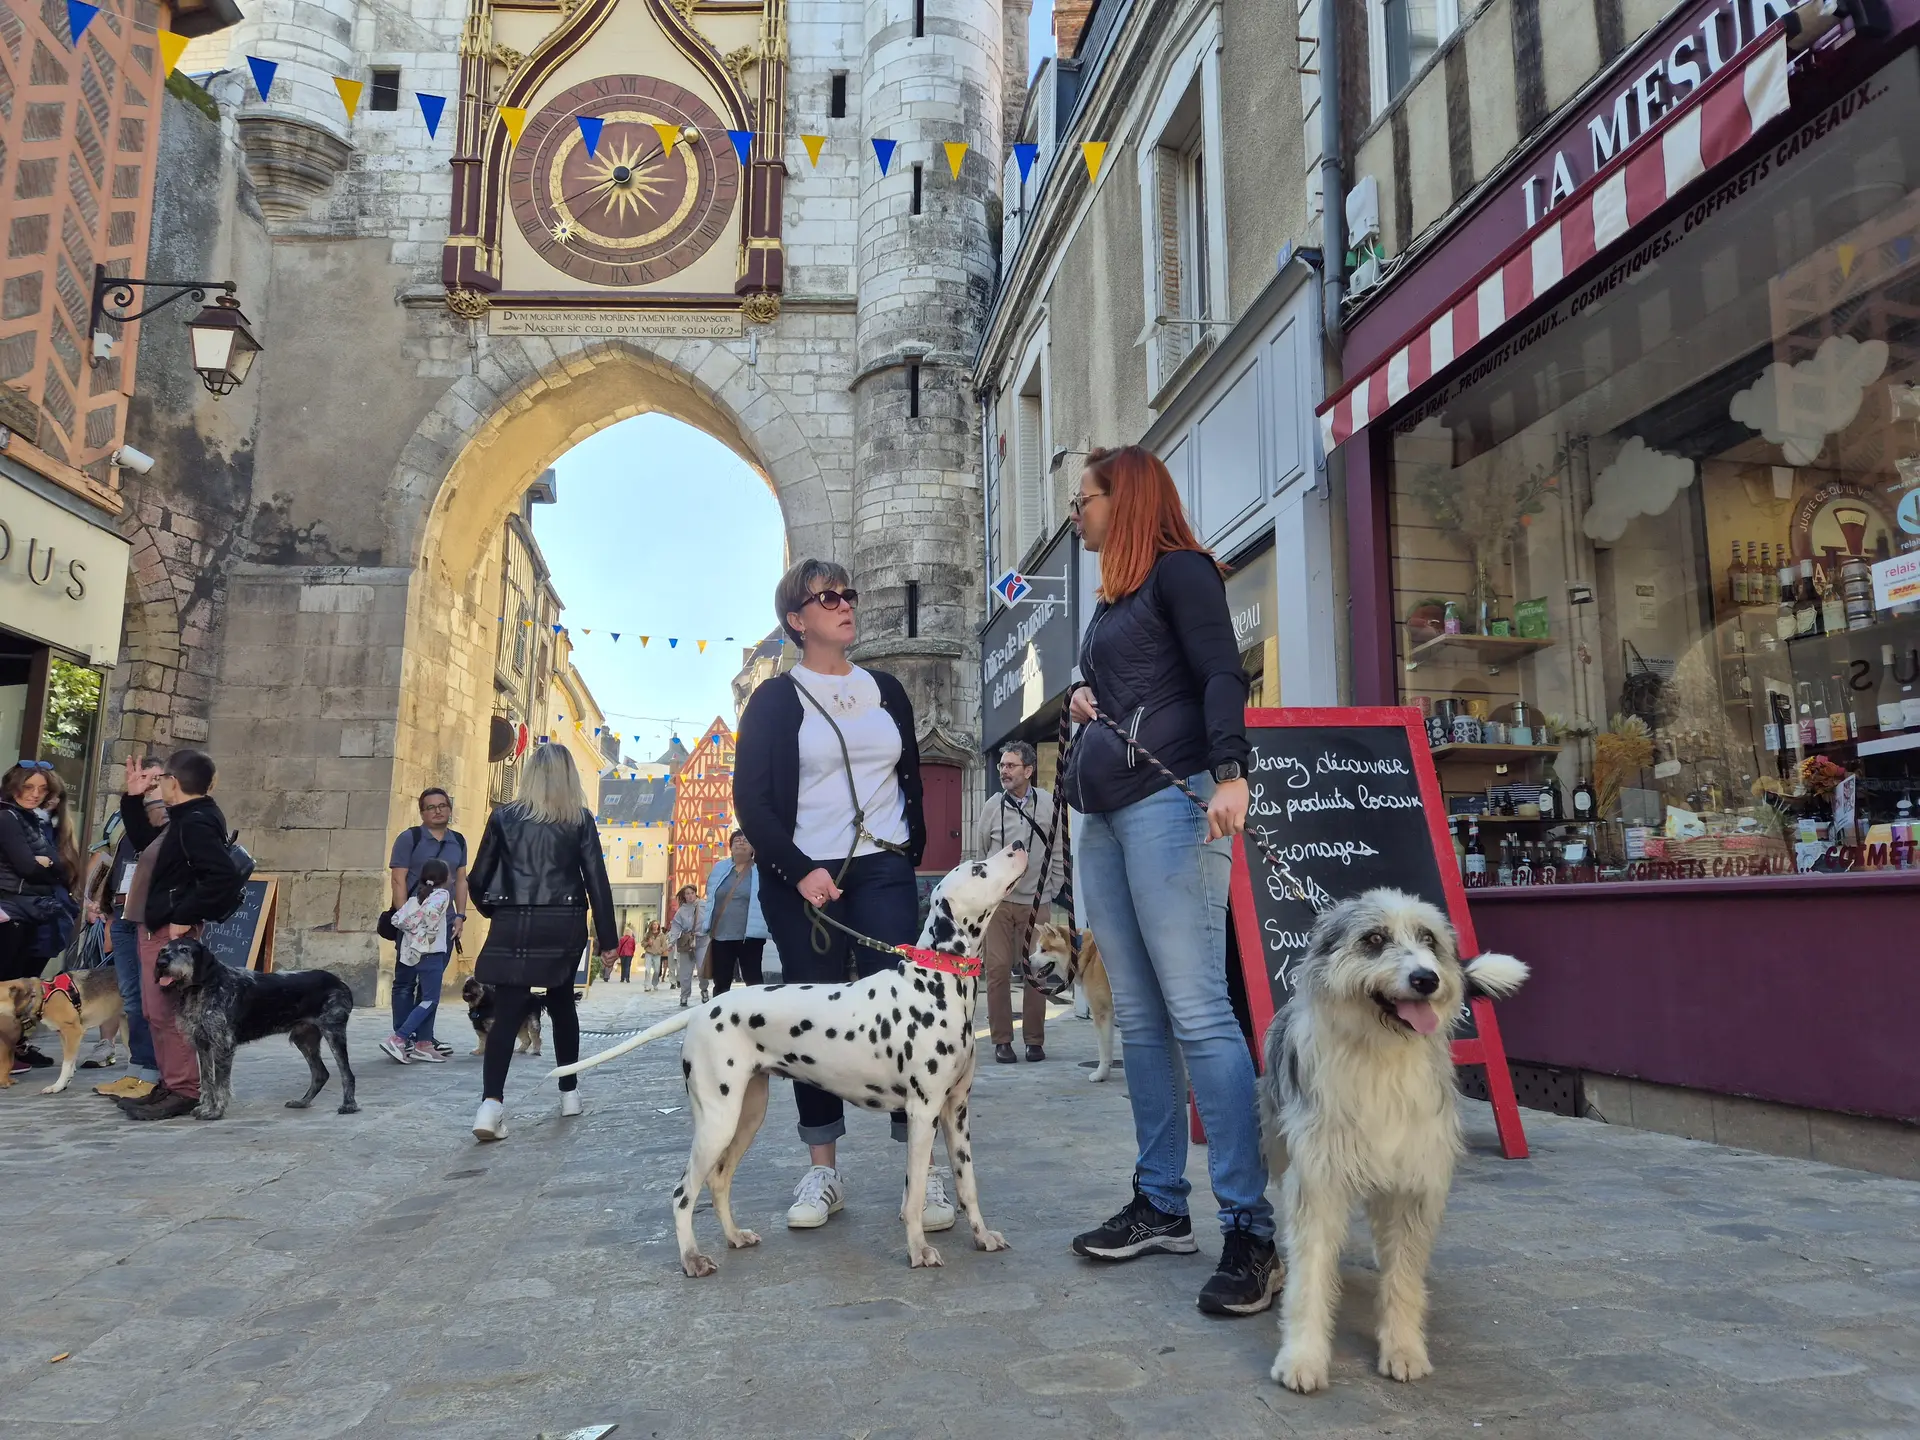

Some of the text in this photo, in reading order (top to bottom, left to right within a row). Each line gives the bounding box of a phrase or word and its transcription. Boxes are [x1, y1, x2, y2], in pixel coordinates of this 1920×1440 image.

[1522, 151, 1575, 229] LA
[1684, 156, 1771, 234] COFFRETS
[524, 322, 566, 333] NASCERE
[637, 314, 665, 322] TAMEN
[1799, 500, 1817, 533] JUSTE
[1815, 489, 1829, 502] CE
[1828, 485, 1854, 495] QU'IL
[1885, 561, 1917, 578] relais
[1004, 632, 1017, 664] de
[993, 682, 1004, 710] de
[1249, 783, 1424, 823] Les produits locaux
[1256, 824, 1380, 866] Fromages
